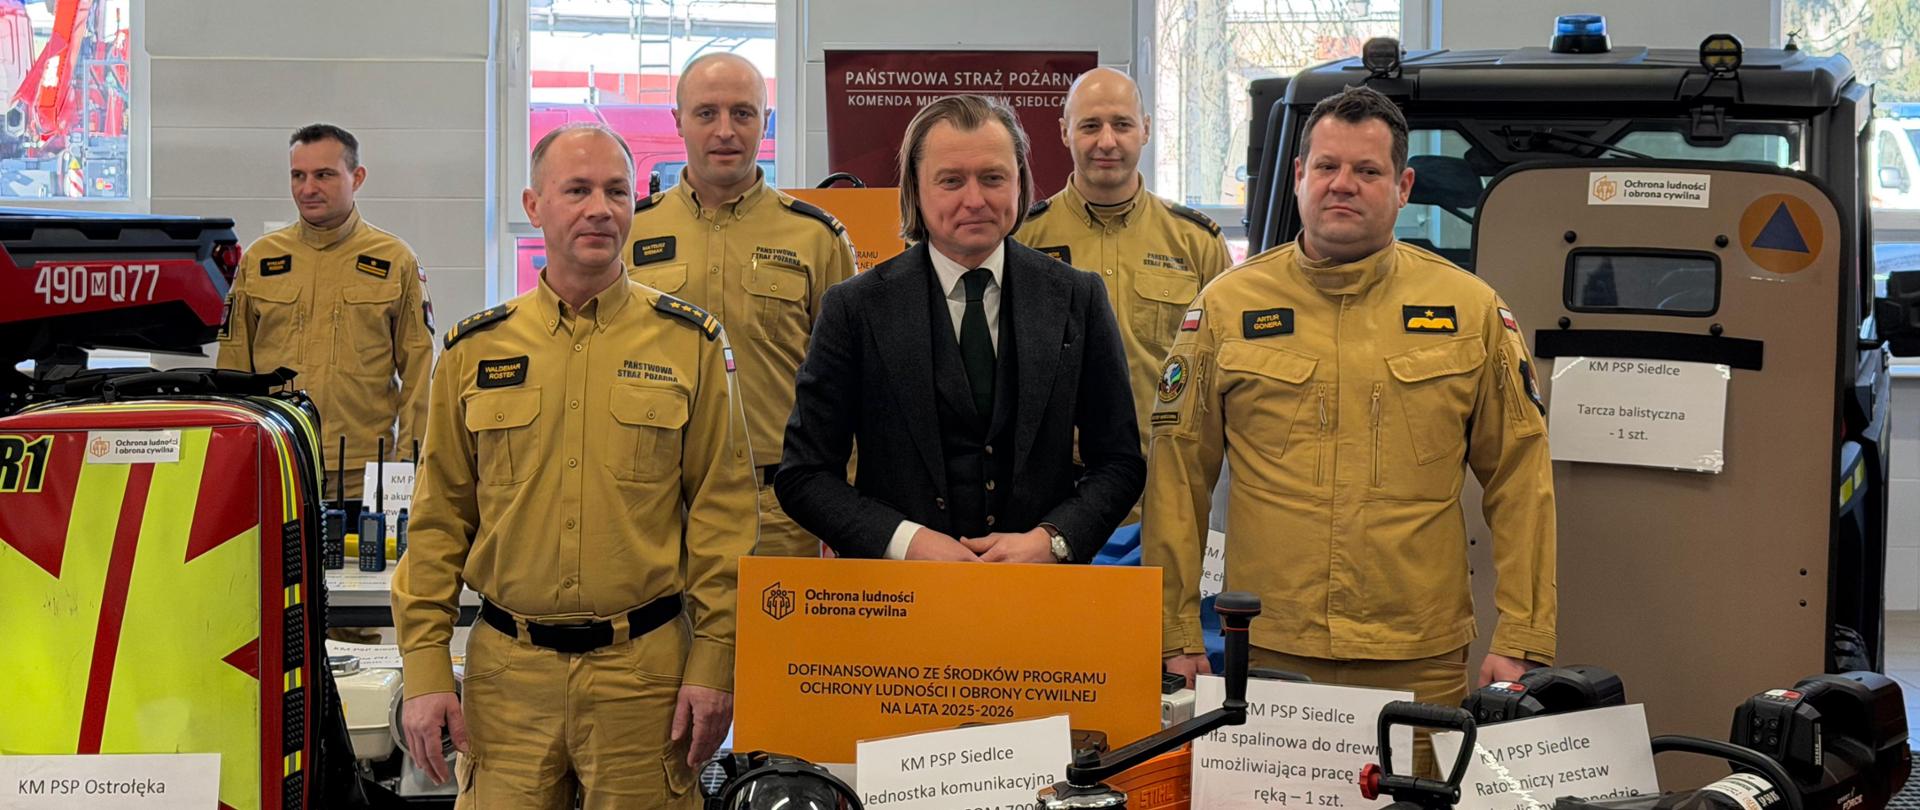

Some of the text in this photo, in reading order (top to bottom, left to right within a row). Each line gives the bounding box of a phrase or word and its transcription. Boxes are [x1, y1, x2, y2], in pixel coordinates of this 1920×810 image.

[846, 68, 1081, 86] PAŃSTWOWA STRAŻ POŻARN
[848, 95, 912, 106] KOMENDA
[1015, 96, 1066, 107] SIEDLCA
[1624, 180, 1707, 191] Ochrona ludności
[1624, 190, 1701, 201] i obrona cywilna
[1253, 320, 1283, 331] GONERA
[1256, 313, 1280, 323] ARTUR
[485, 362, 522, 373] WALDEMAR
[488, 370, 516, 380] ROSTEK
[617, 369, 642, 379] STRAŻ
[623, 359, 674, 375] PAŃSTWOWA
[1589, 361, 1681, 377] KM PSP Siedlce
[1577, 403, 1687, 422] Tarcza balistyczna
[115, 439, 148, 447] Ochrona
[1618, 429, 1625, 439] 1
[1628, 430, 1649, 441] szt.
[119, 447, 146, 455] obrona
[147, 446, 174, 455] cywilna
[805, 588, 915, 603] Ochrona ludności
[804, 603, 907, 619] i obrona cywilna
[788, 663, 1106, 685] DOFINANSOWANO ZE ŚRODKÓW PROGRAMU
[800, 681, 1097, 703] OCHRONY LUDNOŚCI I OBRONY CYWILNEJ
[880, 702, 1014, 718] NA LATA 2025-2026
[1271, 704, 1298, 719] PSP
[1302, 706, 1355, 724] Siedlce
[1231, 731, 1307, 750] spalinowa
[1312, 736, 1331, 751] do
[1336, 738, 1380, 756] drew
[1508, 743, 1534, 761] PSP
[1537, 735, 1591, 756] Siedlce
[901, 747, 1014, 772] KM PSP Siedlce
[1201, 757, 1307, 779] umożliwiająca
[1311, 766, 1354, 785] pracę
[18, 778, 166, 797] KM PSP Ostrołęka
[1476, 764, 1610, 797] Ratoniczy zestaw
[863, 772, 1055, 806] Jednostka komunikacyjna
[1254, 787, 1287, 806] ręką
[1305, 791, 1313, 805] 1
[1318, 794, 1344, 808] szt.
